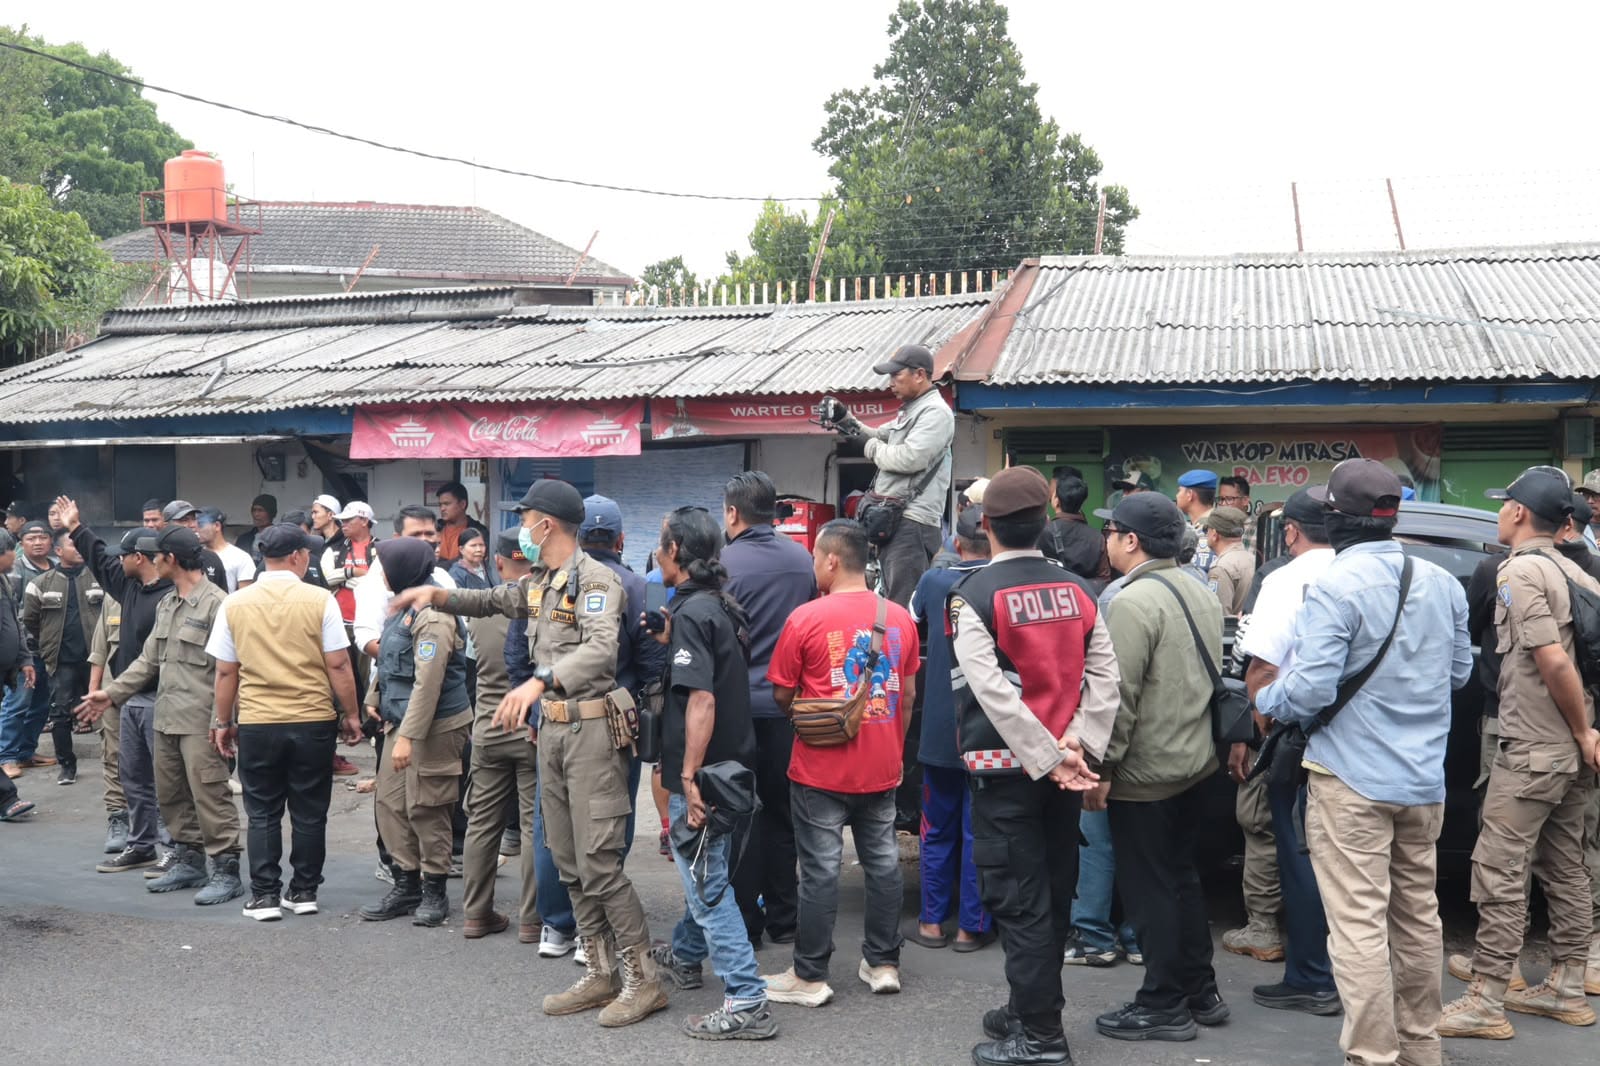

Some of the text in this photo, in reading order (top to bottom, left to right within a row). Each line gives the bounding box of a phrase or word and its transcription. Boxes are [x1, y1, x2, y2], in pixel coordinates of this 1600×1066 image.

[730, 405, 805, 417] WARTEG
[1182, 441, 1363, 463] WARKOP MIRASA
[1006, 587, 1080, 623] POLISI
